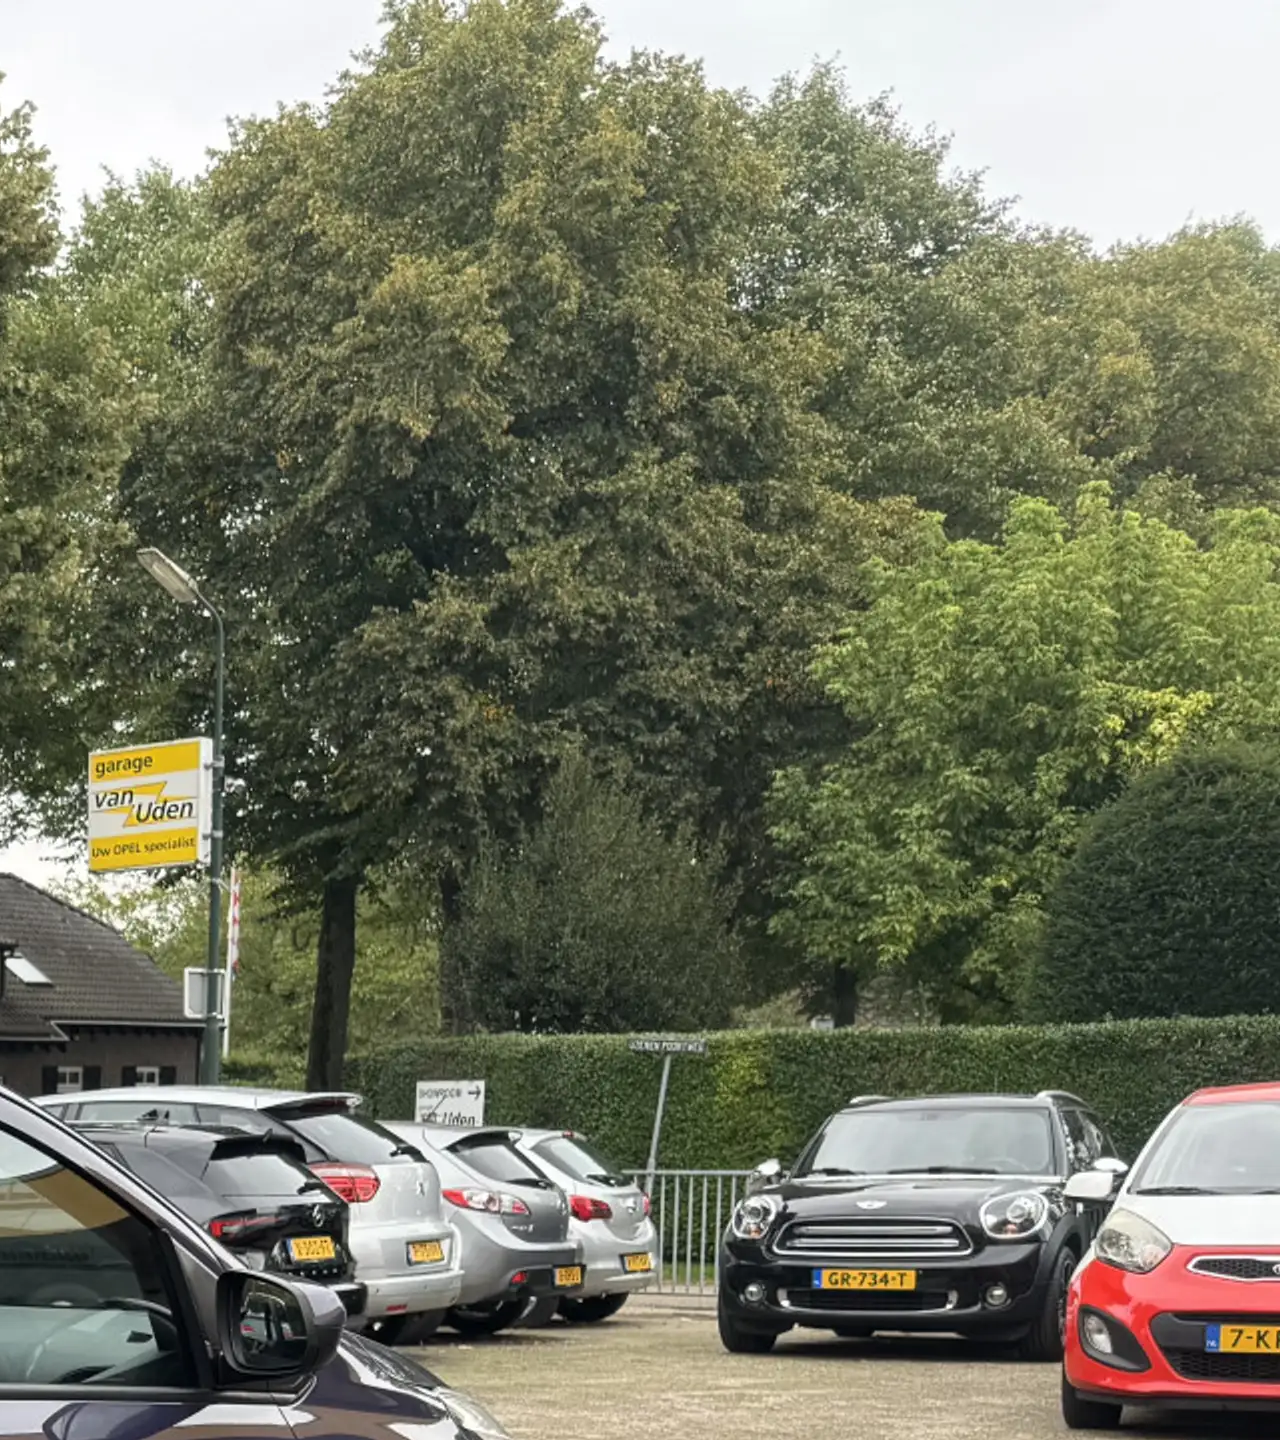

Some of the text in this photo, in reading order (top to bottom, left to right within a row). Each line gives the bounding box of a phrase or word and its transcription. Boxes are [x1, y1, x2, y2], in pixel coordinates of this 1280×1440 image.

[95, 755, 153, 778] garage
[95, 790, 193, 824] van Uden
[92, 837, 196, 858] Uw OPEL specialist
[828, 1272, 907, 1288] GR-734-T
